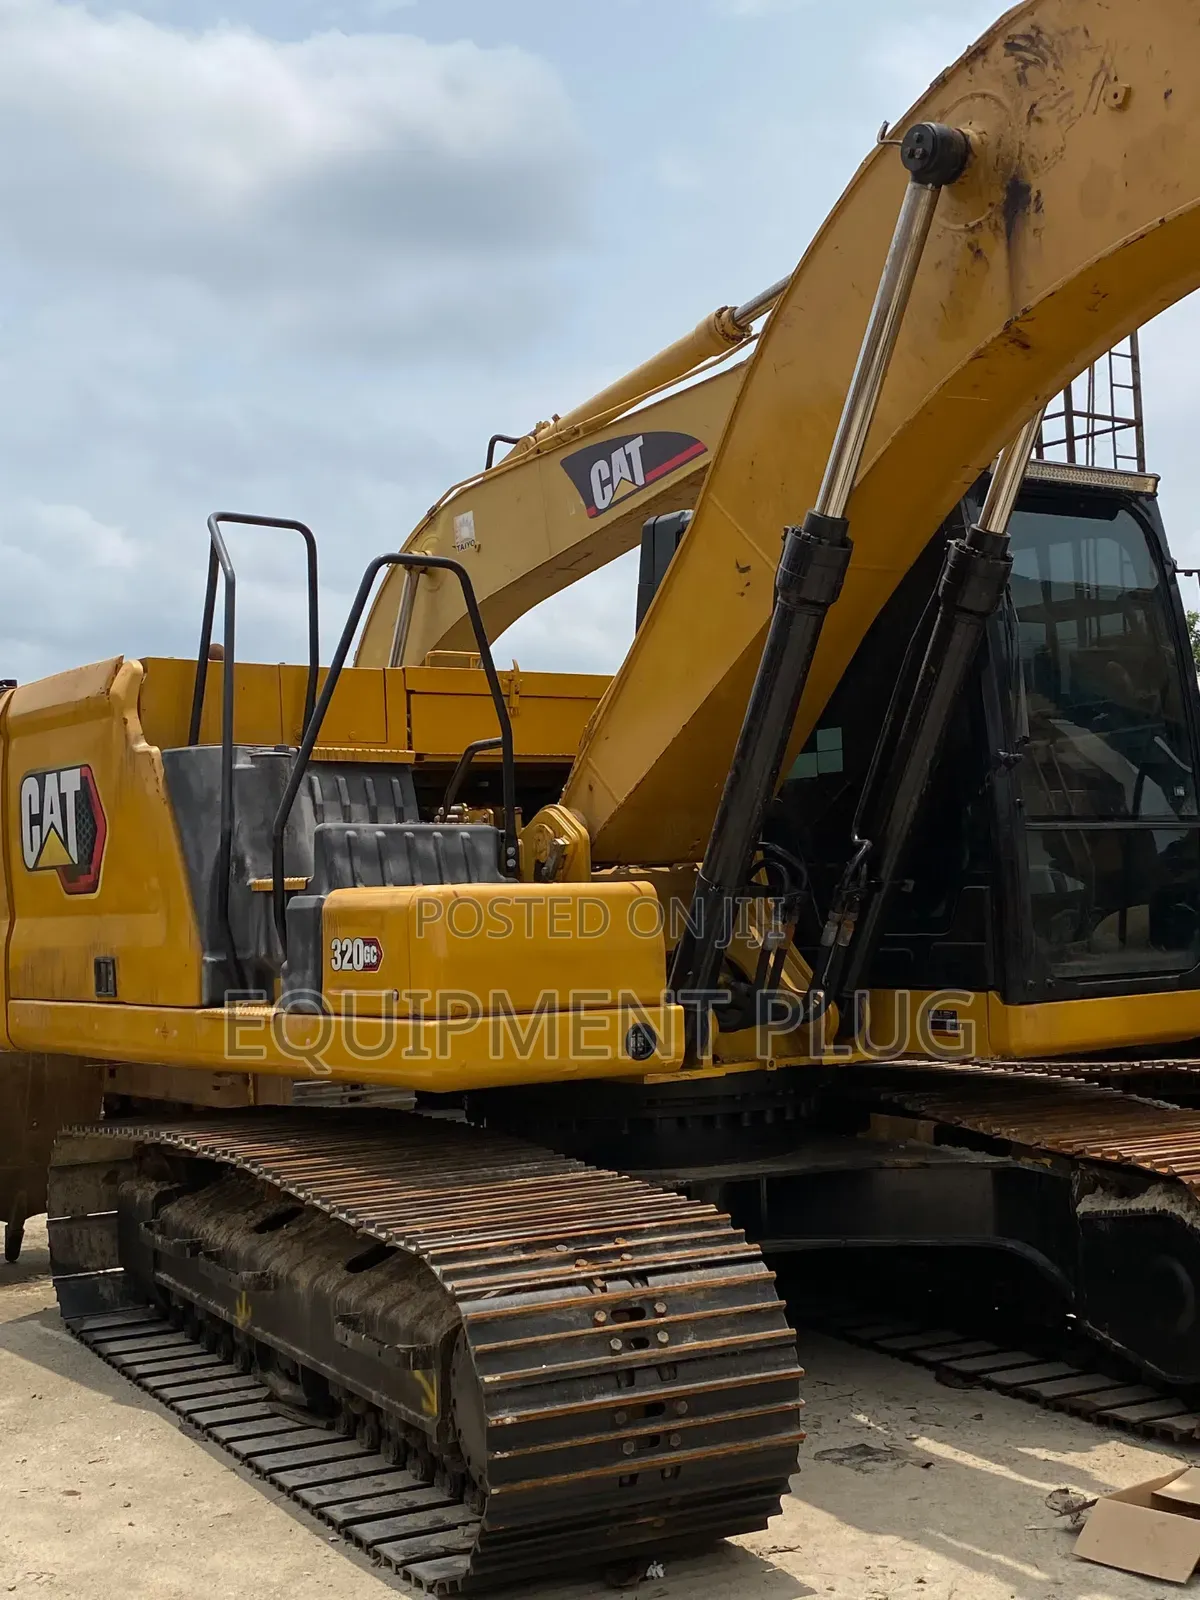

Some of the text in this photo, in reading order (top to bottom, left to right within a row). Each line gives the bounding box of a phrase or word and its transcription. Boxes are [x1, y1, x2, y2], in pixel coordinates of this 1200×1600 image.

[590, 434, 645, 510] CAT
[456, 539, 476, 552] TAIYO
[21, 768, 81, 869] CAT
